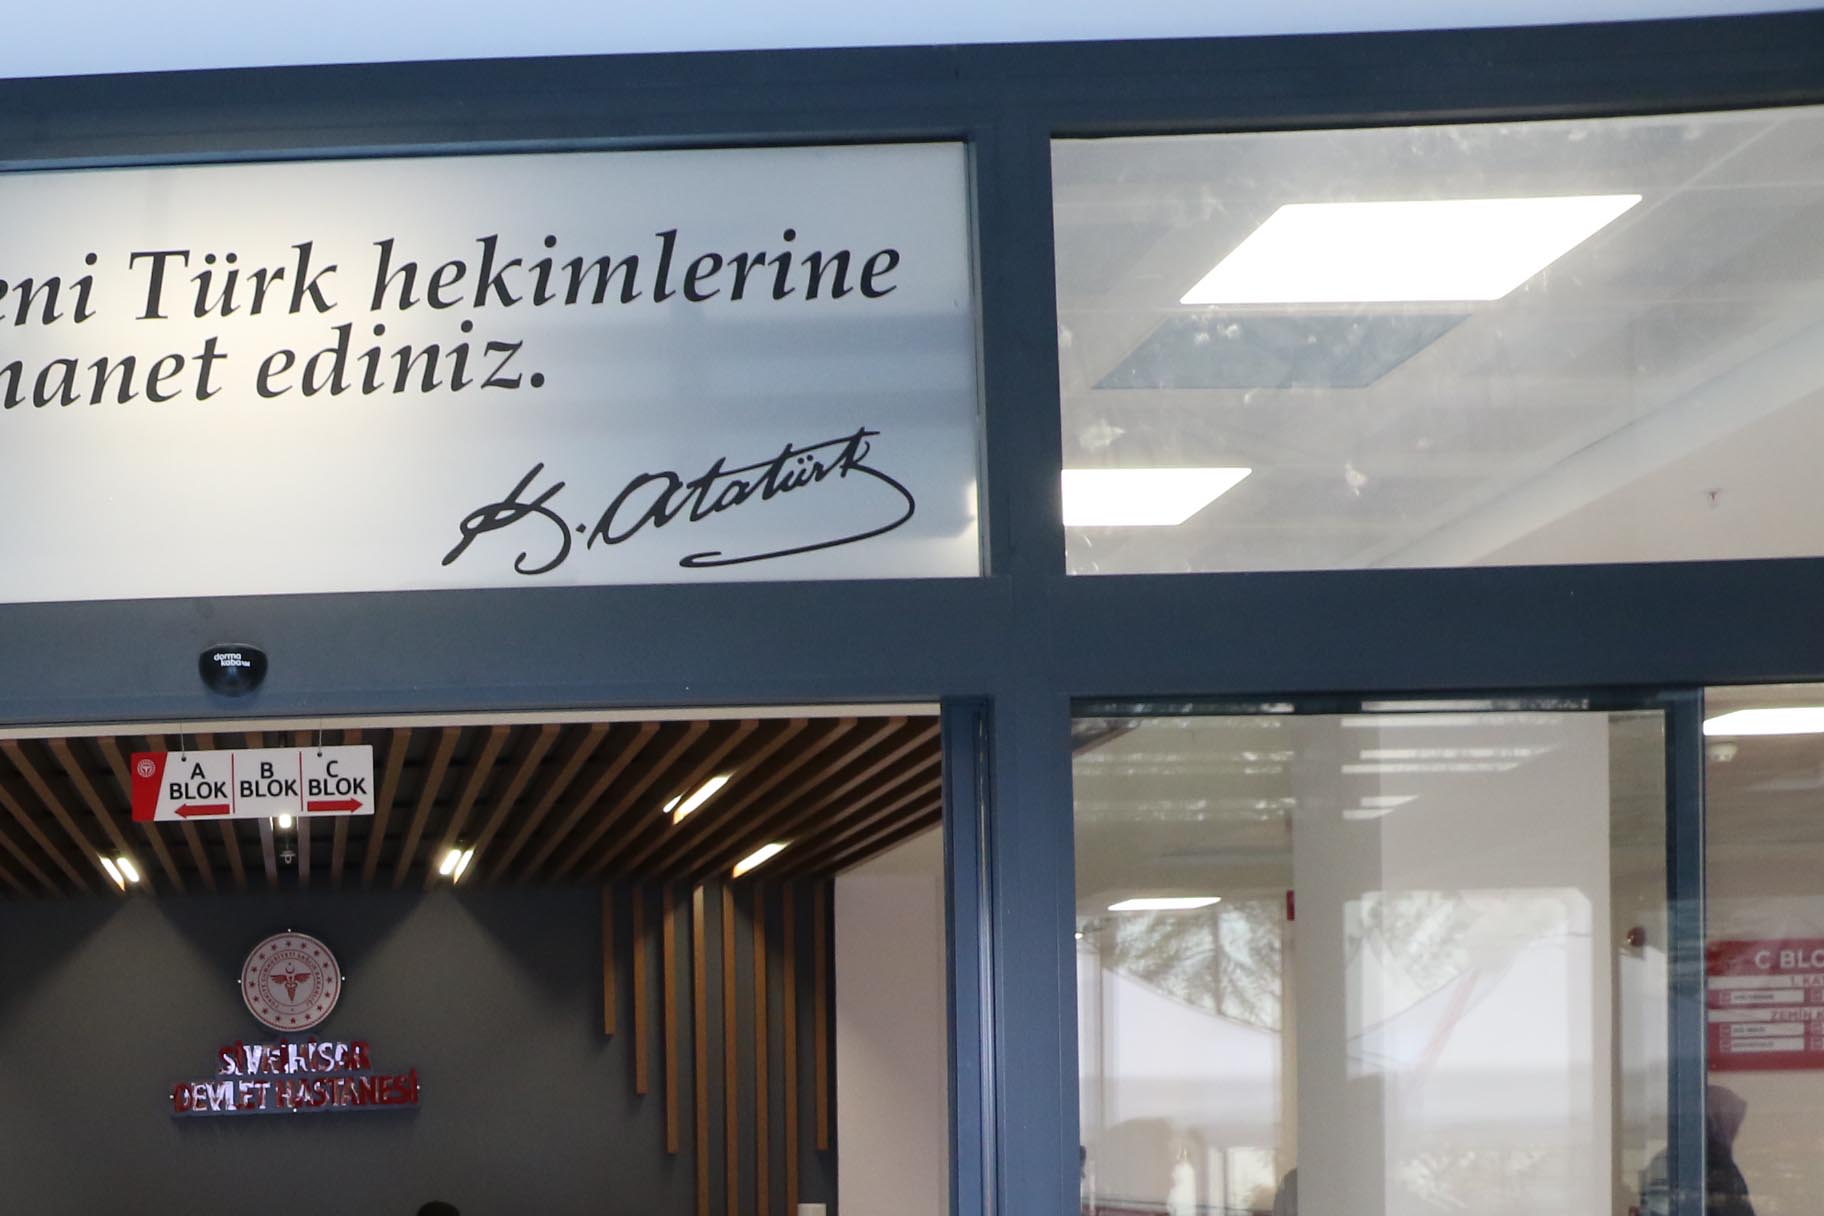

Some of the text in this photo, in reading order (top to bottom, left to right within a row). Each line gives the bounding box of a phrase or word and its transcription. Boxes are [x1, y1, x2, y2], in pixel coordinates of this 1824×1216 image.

[129, 241, 337, 319] Türk
[370, 228, 900, 314] hekimlerine
[256, 319, 545, 398] ediniz.
[213, 653, 242, 661] dorma
[190, 762, 206, 780] A
[259, 762, 275, 779] B
[326, 760, 339, 777] C
[169, 781, 229, 800] BLOK
[240, 779, 299, 798] BLOK
[308, 777, 368, 796] BLOK
[1754, 948, 1824, 970] C BLO
[173, 1079, 271, 1113] DEVLET
